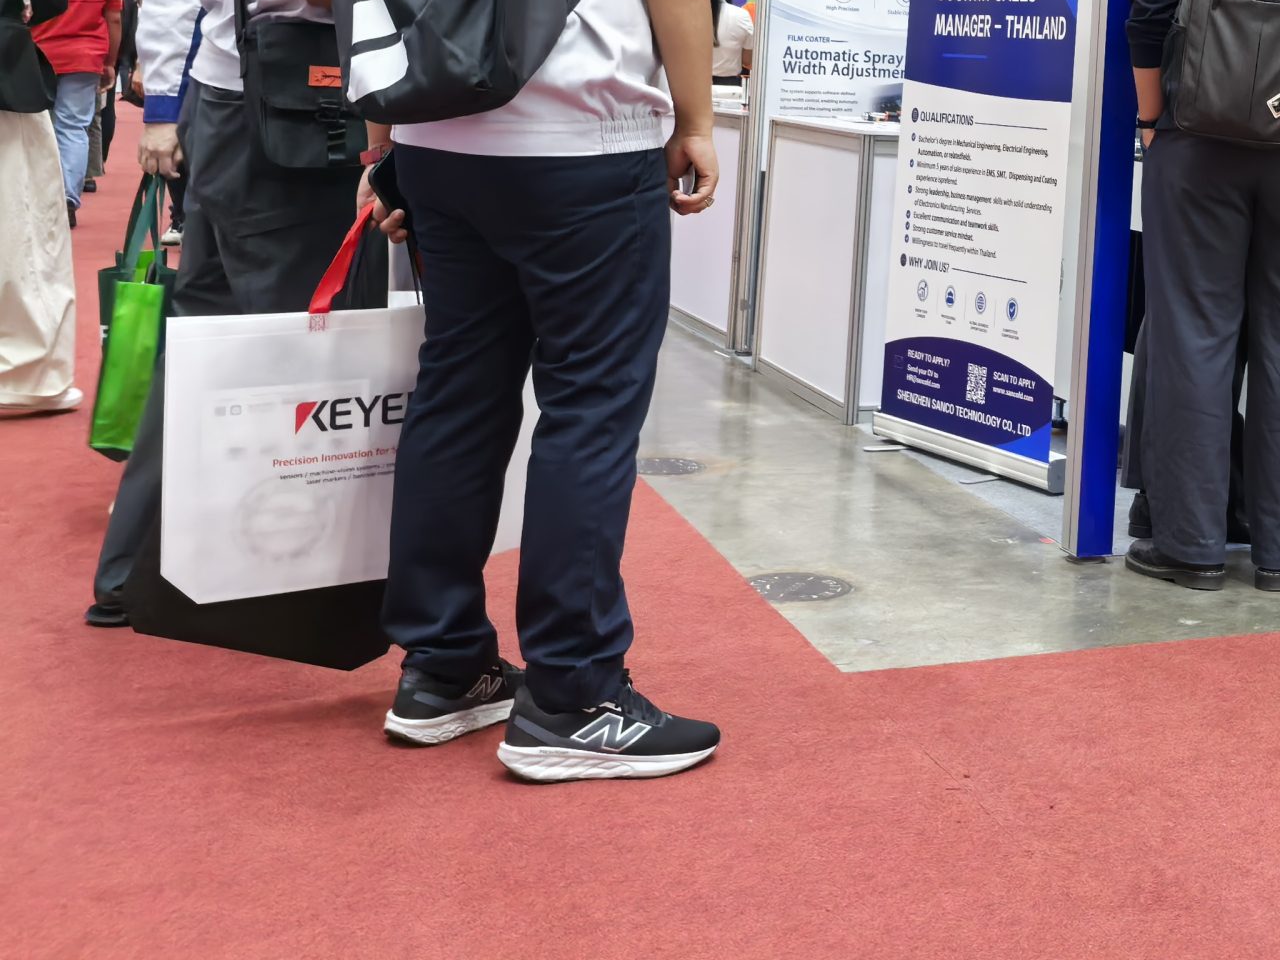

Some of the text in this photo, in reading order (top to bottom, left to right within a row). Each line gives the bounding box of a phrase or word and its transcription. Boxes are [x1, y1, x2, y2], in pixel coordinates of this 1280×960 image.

[934, 13, 1067, 41] MANAGER THAILAND
[787, 34, 831, 43] FILM COATER
[783, 46, 904, 68] Automatic Spray
[783, 60, 826, 75] Width
[920, 111, 974, 126] QUALIFICATIONS
[909, 256, 950, 273] WHY JOIN US?
[907, 349, 951, 368] READY TO APPLY?
[993, 371, 1036, 390] SCAN TO APPLY
[295, 392, 412, 435] KEYE
[897, 389, 1032, 437] SHENZHEN SANCO TECHNOLOGY CO., LTD
[273, 455, 318, 468] Precision
[321, 449, 373, 463] Innovation
[375, 447, 390, 457] for
